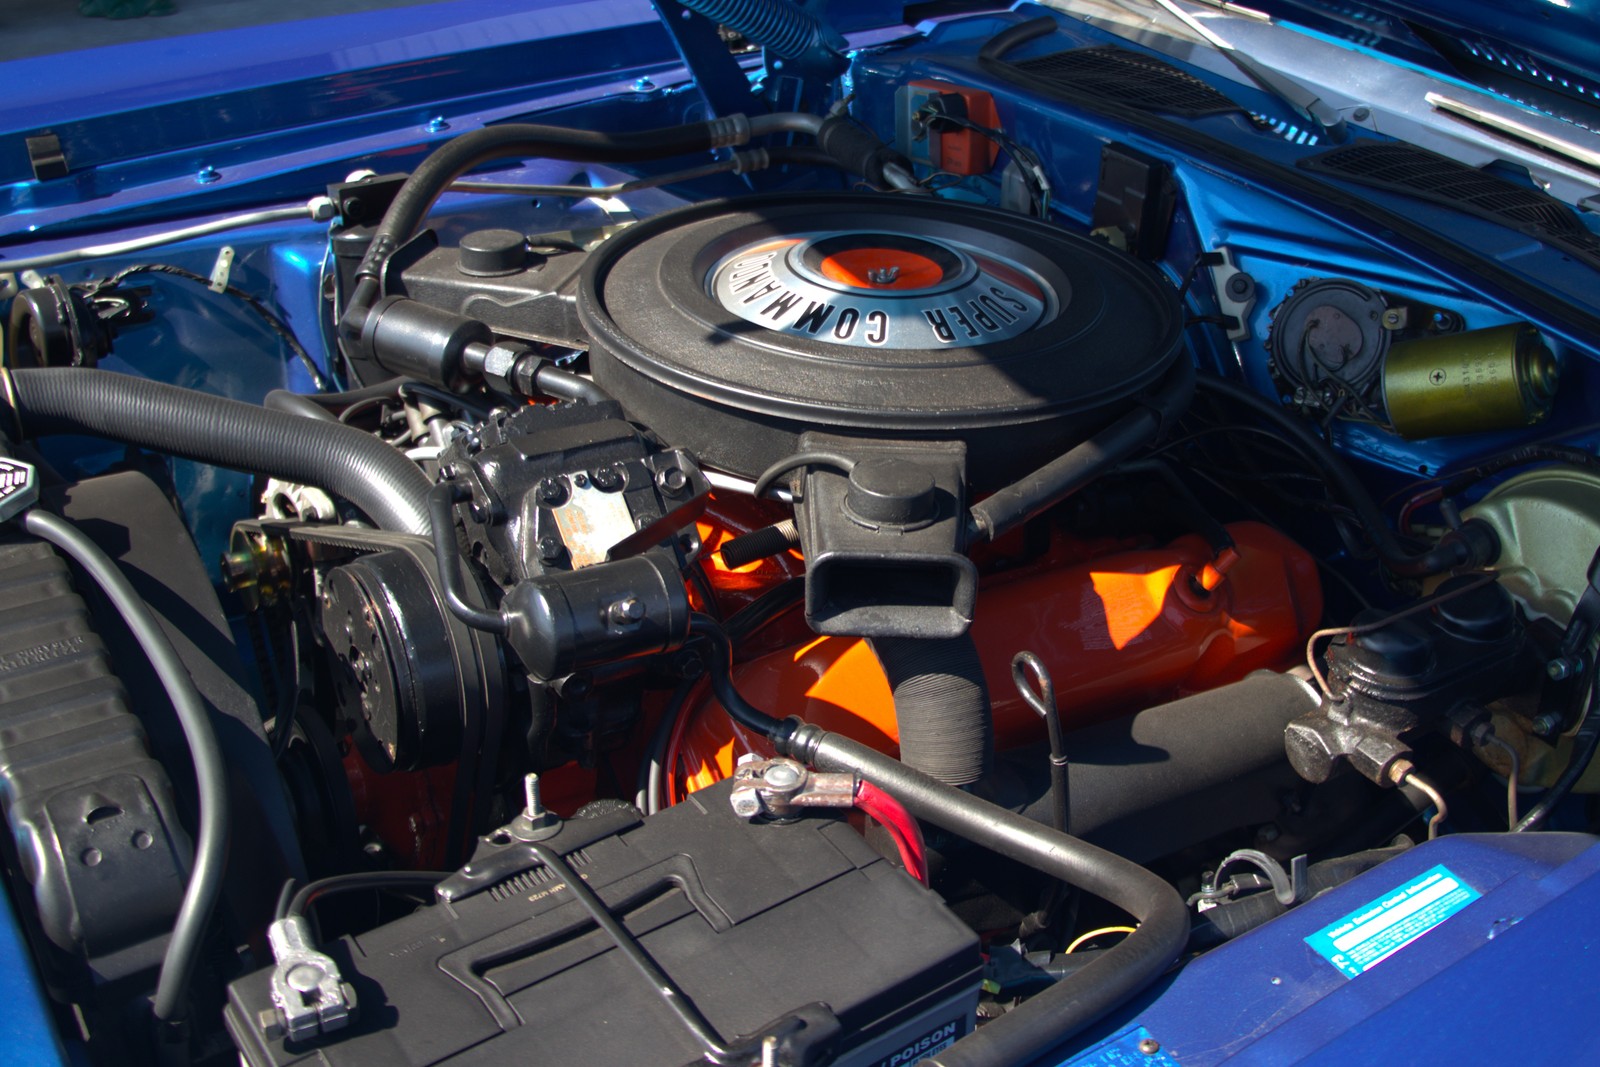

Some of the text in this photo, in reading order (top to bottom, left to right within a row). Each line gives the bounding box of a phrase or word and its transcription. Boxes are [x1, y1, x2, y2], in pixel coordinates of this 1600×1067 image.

[729, 251, 1029, 345] SUPER COMMANDO
[890, 1022, 956, 1067] POISON
